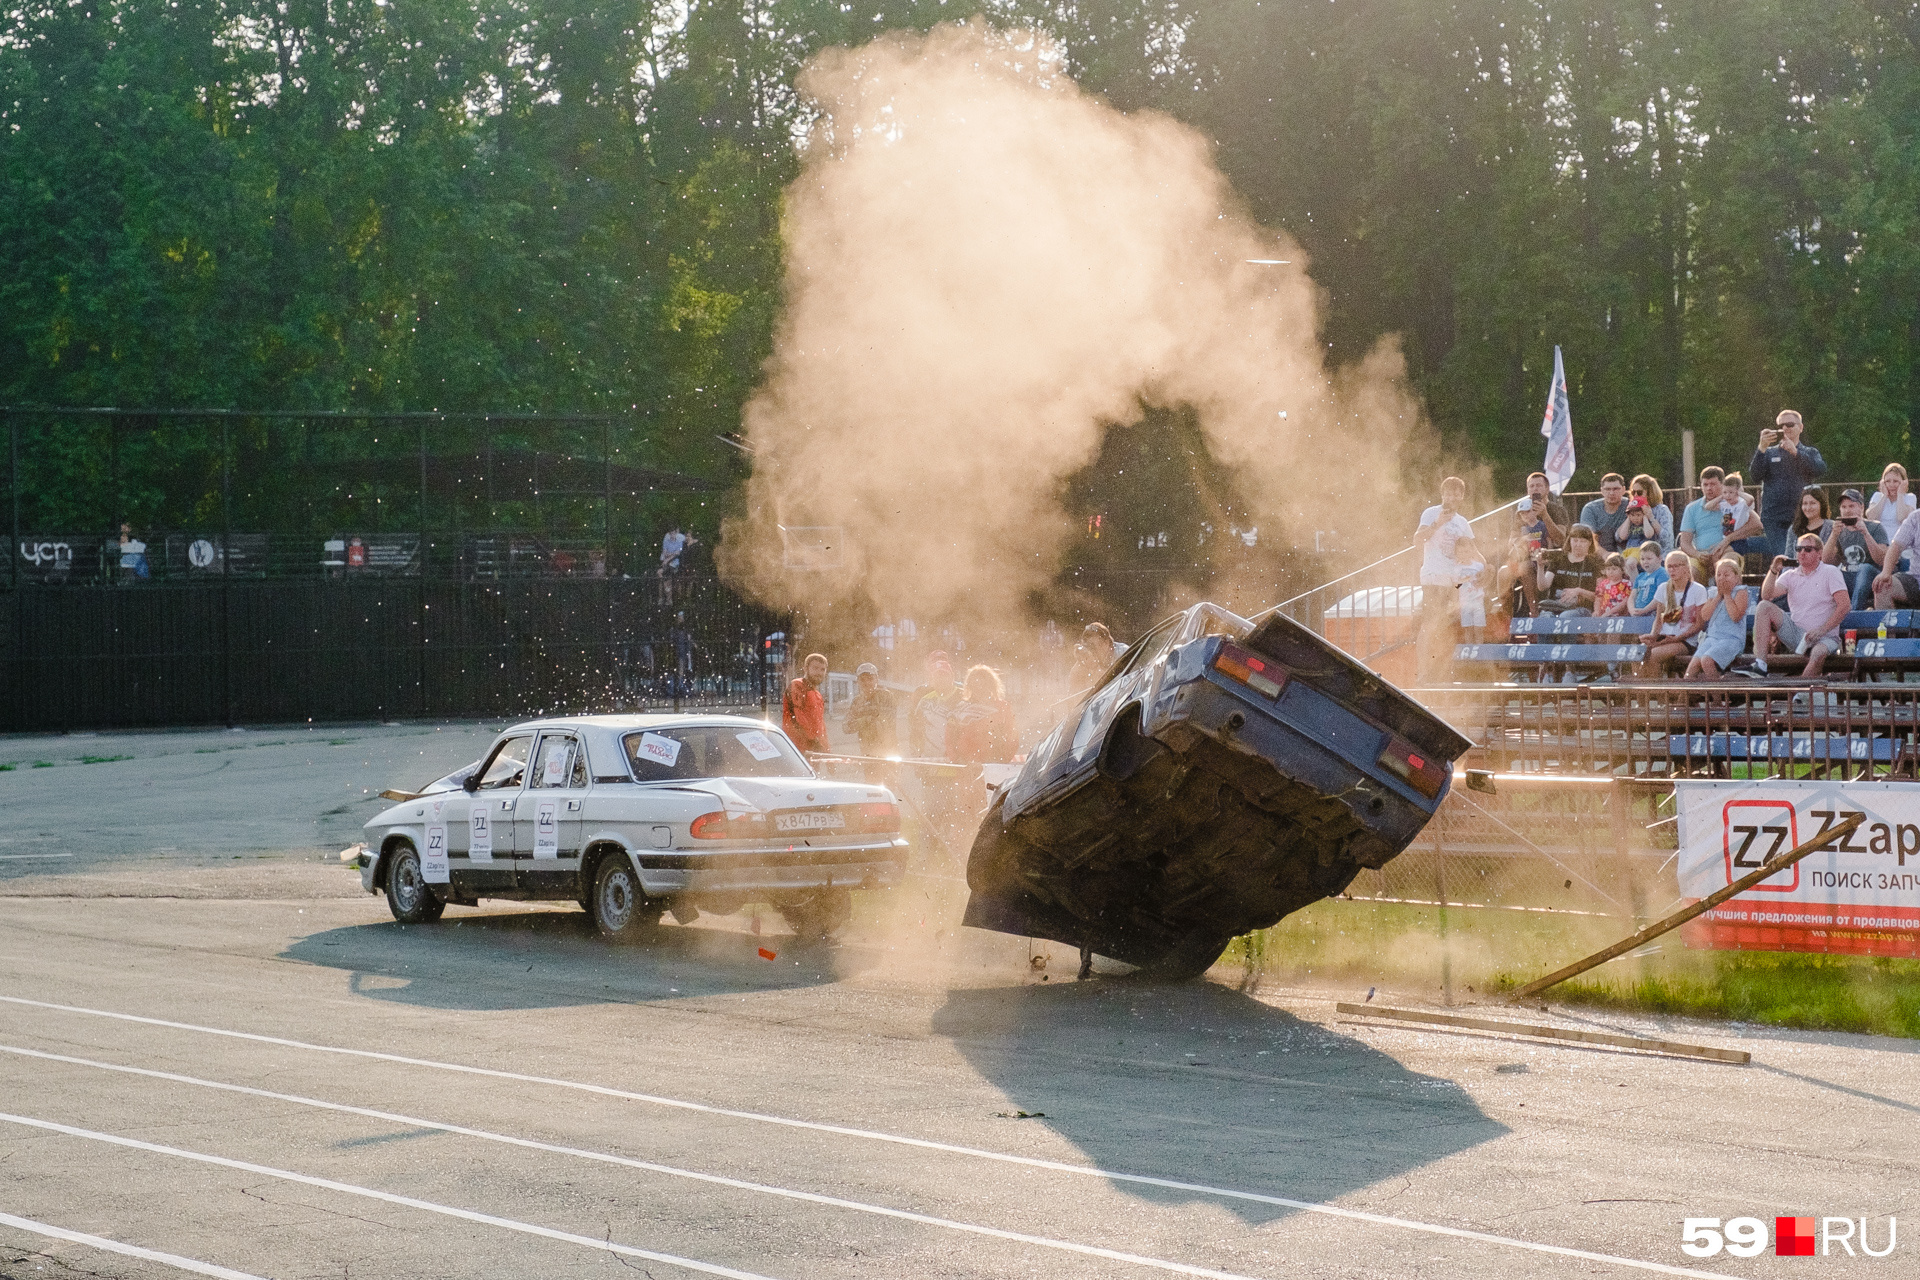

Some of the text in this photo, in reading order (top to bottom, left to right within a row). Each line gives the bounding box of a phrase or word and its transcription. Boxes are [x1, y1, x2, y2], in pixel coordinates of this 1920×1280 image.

[1515, 617, 1624, 634] 28 27 26
[1863, 641, 1885, 657] 65
[540, 812, 552, 826] ZZ
[429, 835, 441, 849] ZZ
[1733, 825, 1791, 869] ZZ
[1812, 871, 1873, 889] ПОИСК
[1751, 911, 1833, 924] предложения
[1836, 915, 1850, 926] от
[1853, 915, 1920, 930] продавцов
[1811, 929, 1828, 938] на
